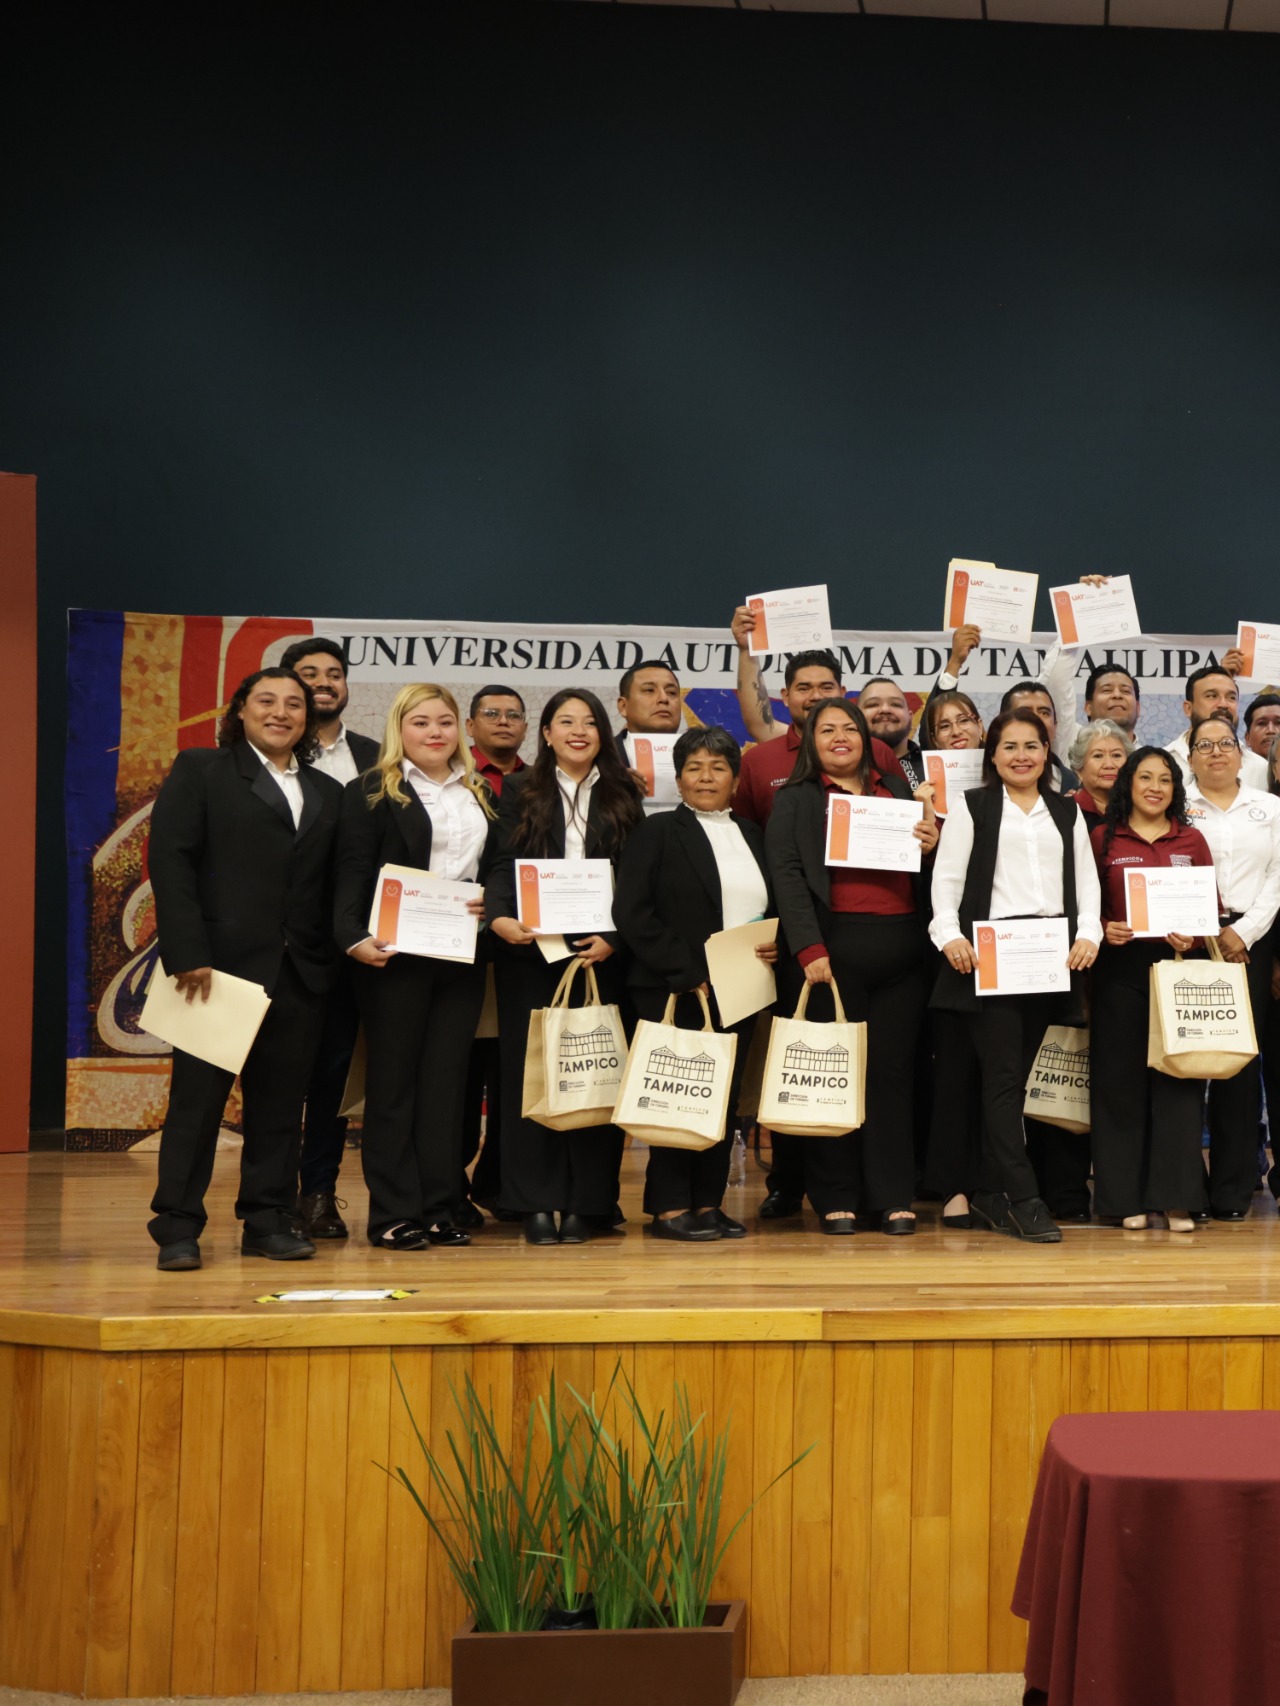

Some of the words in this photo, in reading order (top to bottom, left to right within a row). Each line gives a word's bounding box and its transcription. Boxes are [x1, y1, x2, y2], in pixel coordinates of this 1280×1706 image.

[340, 636, 644, 670] UNIVERSIDAD
[658, 640, 904, 676] AUTMA
[403, 889, 420, 897] UAT
[1175, 1008, 1237, 1021] TAMPICO
[558, 1056, 619, 1073] TAMPICO
[643, 1076, 712, 1099] TAMPICO
[781, 1072, 849, 1089] TAMPICO
